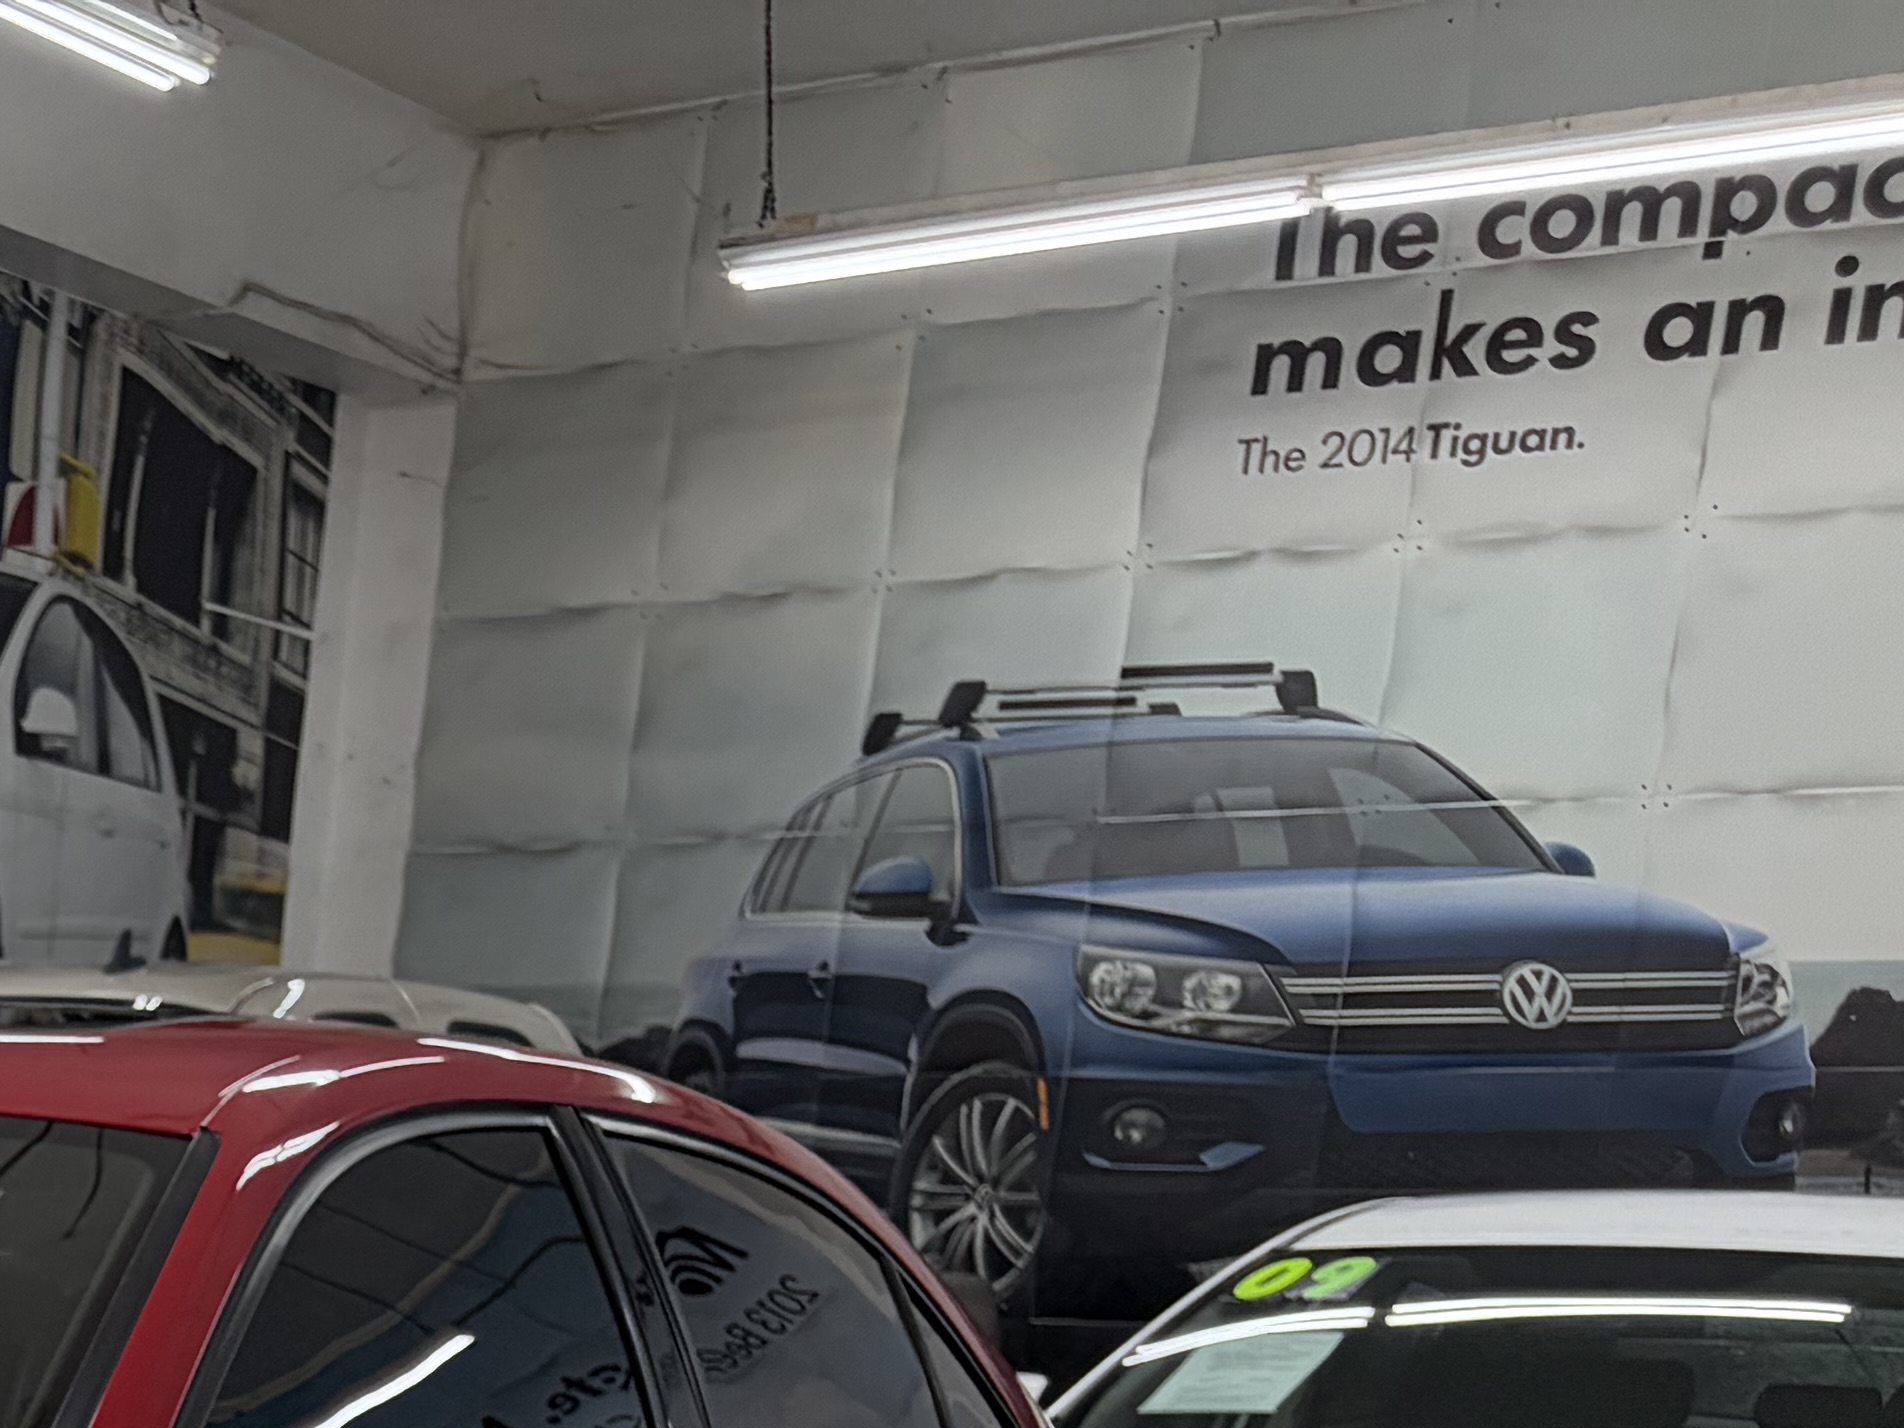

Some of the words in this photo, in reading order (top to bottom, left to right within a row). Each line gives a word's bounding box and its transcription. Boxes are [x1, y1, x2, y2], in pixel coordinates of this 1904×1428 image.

[1250, 289, 1599, 396] makes
[1644, 292, 1786, 362] an
[1237, 437, 1306, 475] The
[1320, 426, 1416, 471] 2014
[1425, 423, 1586, 467] Tiguan.
[1232, 1256, 1378, 1301] 09
